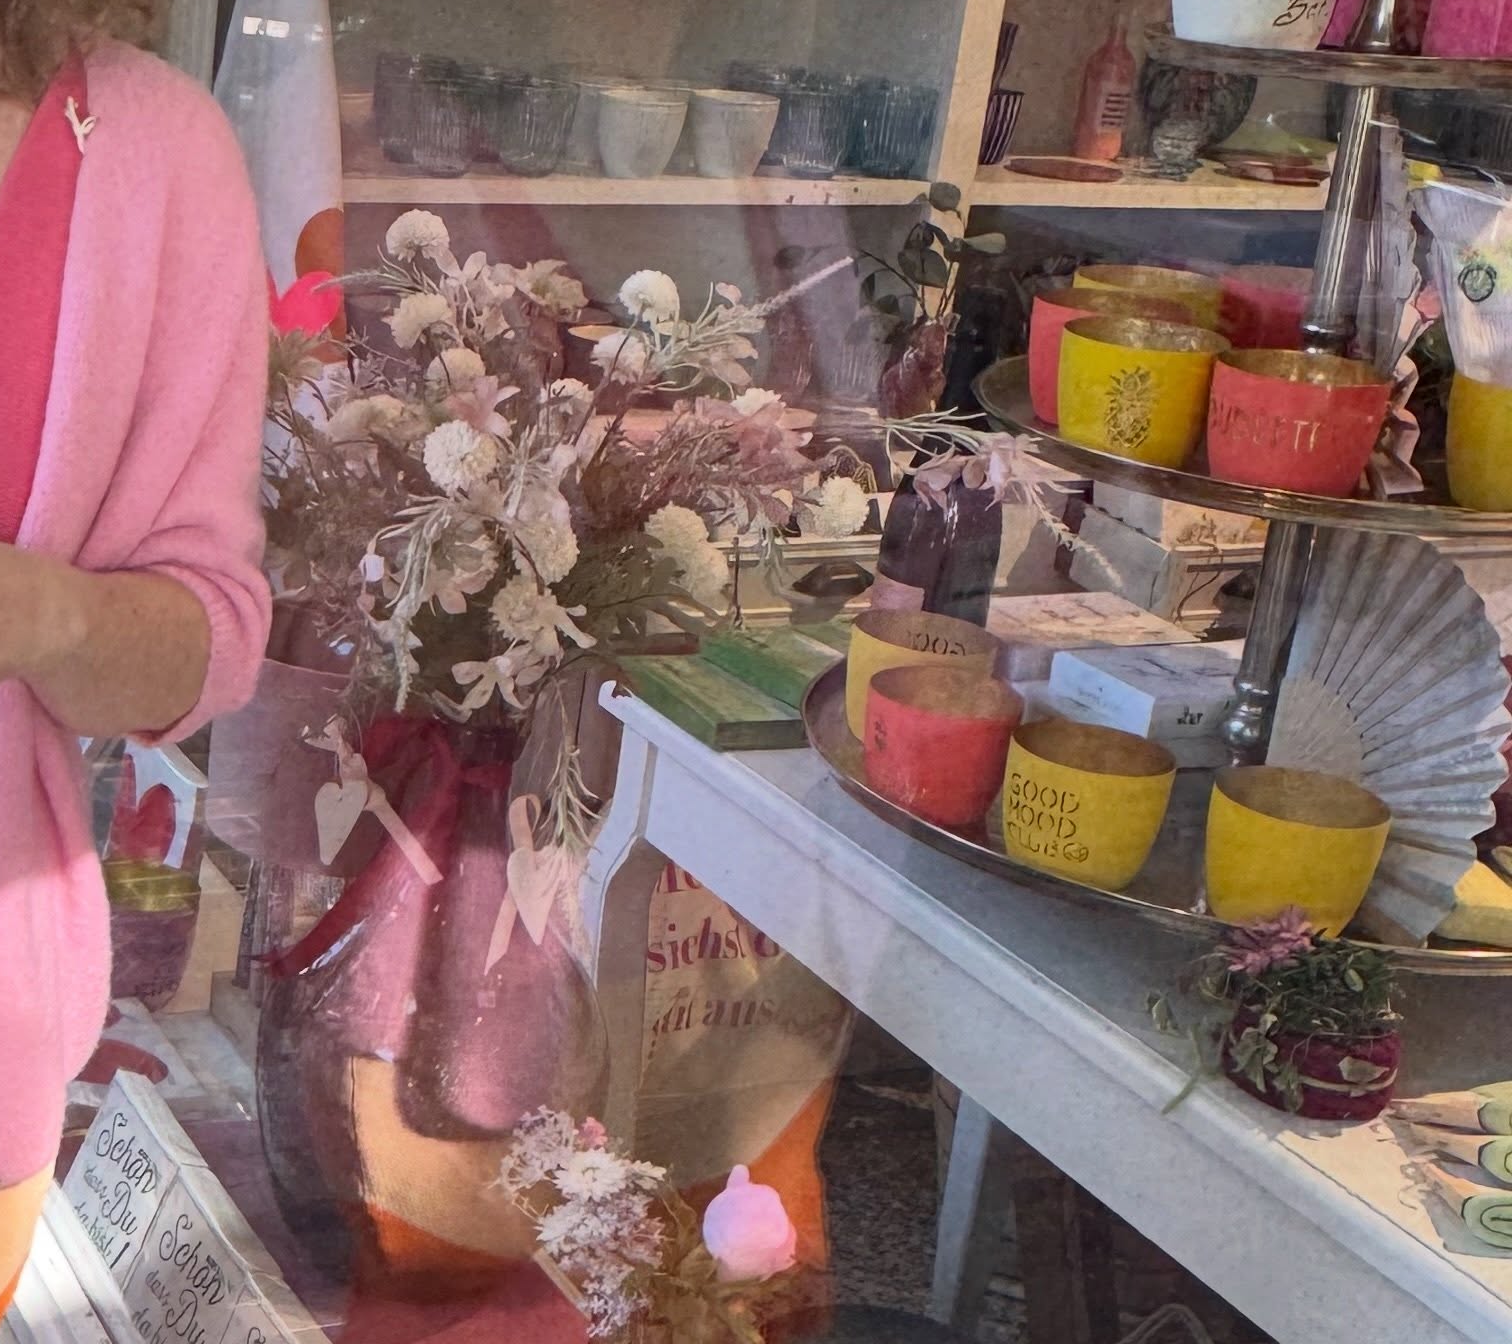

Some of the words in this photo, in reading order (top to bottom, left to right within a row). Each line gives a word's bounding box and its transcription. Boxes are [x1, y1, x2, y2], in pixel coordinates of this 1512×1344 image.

[1011, 772, 1080, 814] GOOD
[1008, 795, 1077, 840] MOOD
[101, 1180, 138, 1236] Du
